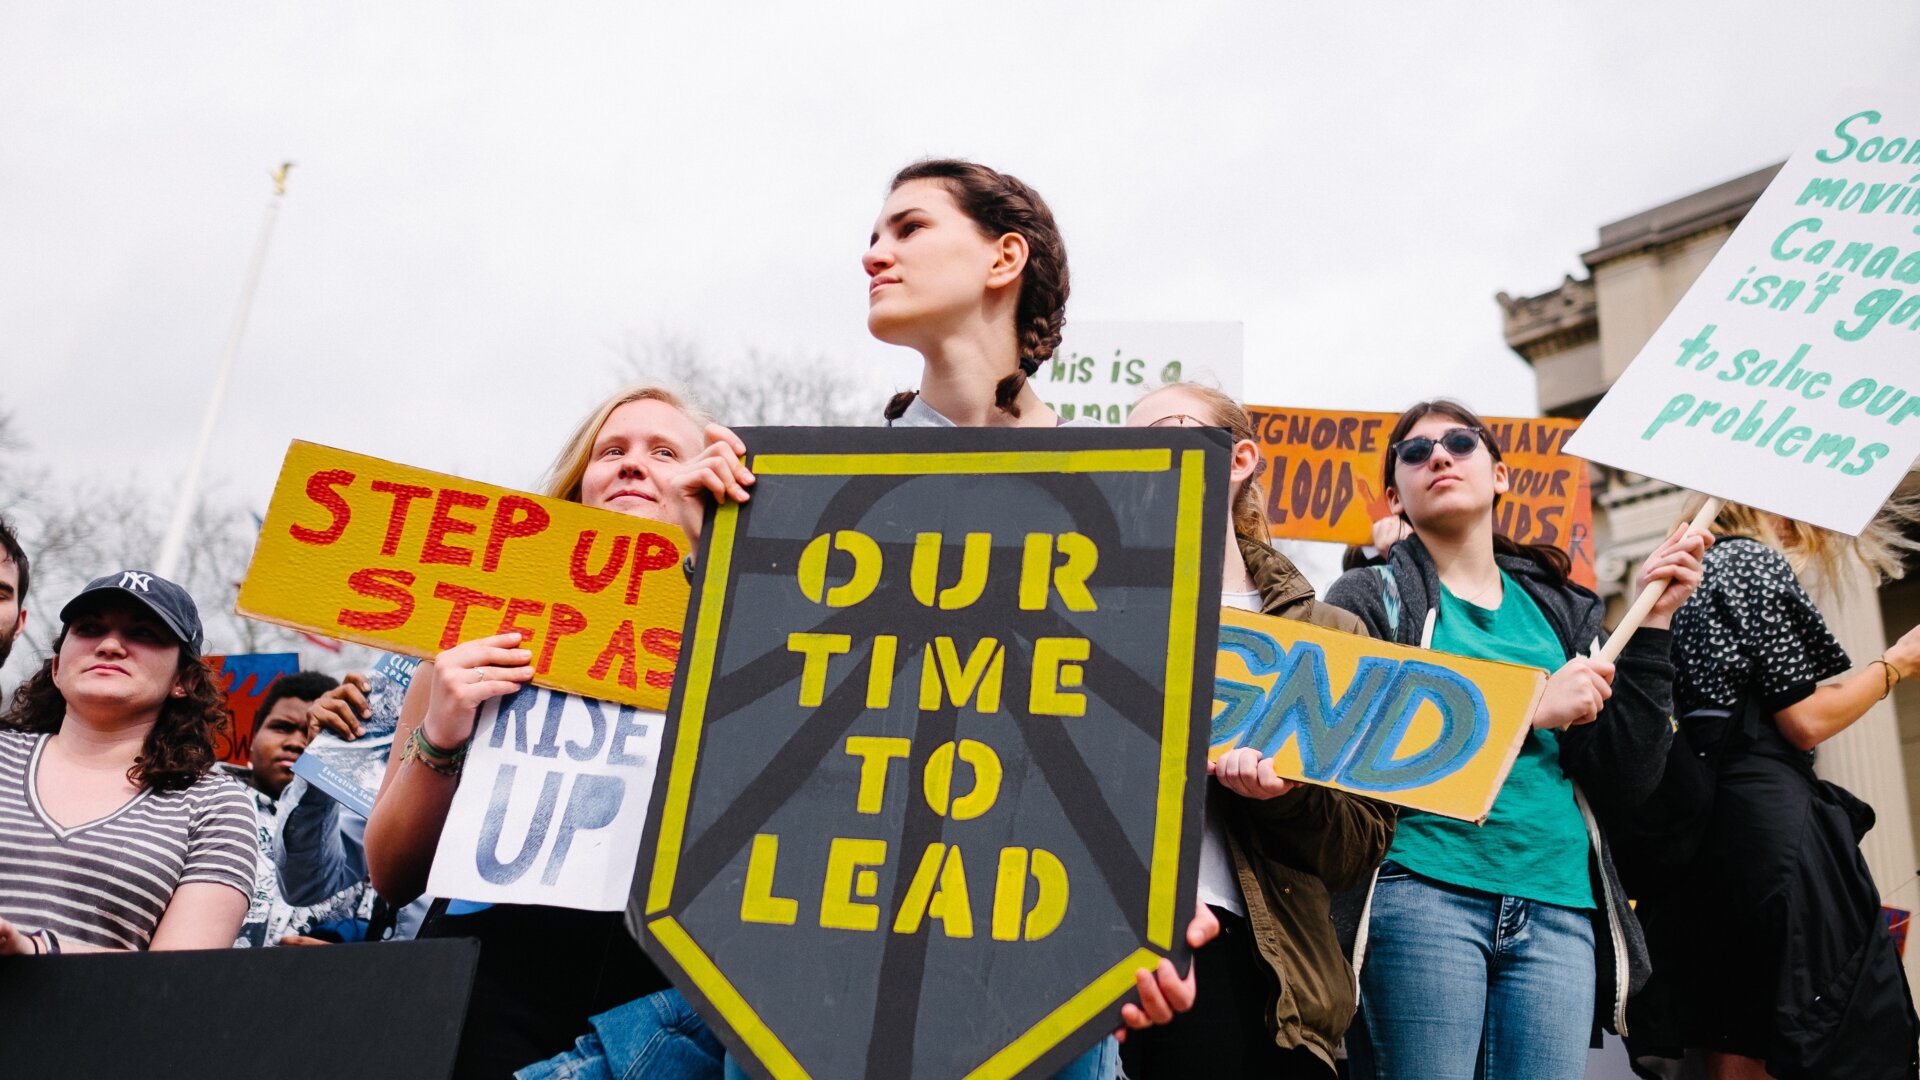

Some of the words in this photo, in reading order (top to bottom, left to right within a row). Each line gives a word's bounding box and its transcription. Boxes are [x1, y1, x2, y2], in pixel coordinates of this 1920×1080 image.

[1794, 173, 1920, 235] movin
[1726, 265, 1845, 314] isn't
[1833, 288, 1920, 342] go
[1048, 349, 1095, 383] his
[1110, 349, 1145, 384] is
[1160, 360, 1182, 383] a
[1675, 324, 1719, 371] to
[1716, 343, 1832, 400] solve
[1838, 377, 1920, 425] our
[1249, 411, 1383, 454] IGNORE
[1641, 393, 1890, 476] problems
[1507, 466, 1571, 498] YOUR
[289, 469, 551, 573] STEP
[569, 529, 680, 606] UP
[797, 530, 1099, 612] OUR
[118, 571, 154, 592] NY
[337, 567, 588, 675] STEP
[587, 619, 681, 690] AS
[787, 632, 1089, 717] TIME
[1209, 624, 1491, 792] GND
[488, 683, 649, 766] RISE
[845, 735, 1003, 821] TO
[475, 763, 626, 886] UP
[740, 833, 1070, 941] LEAD
